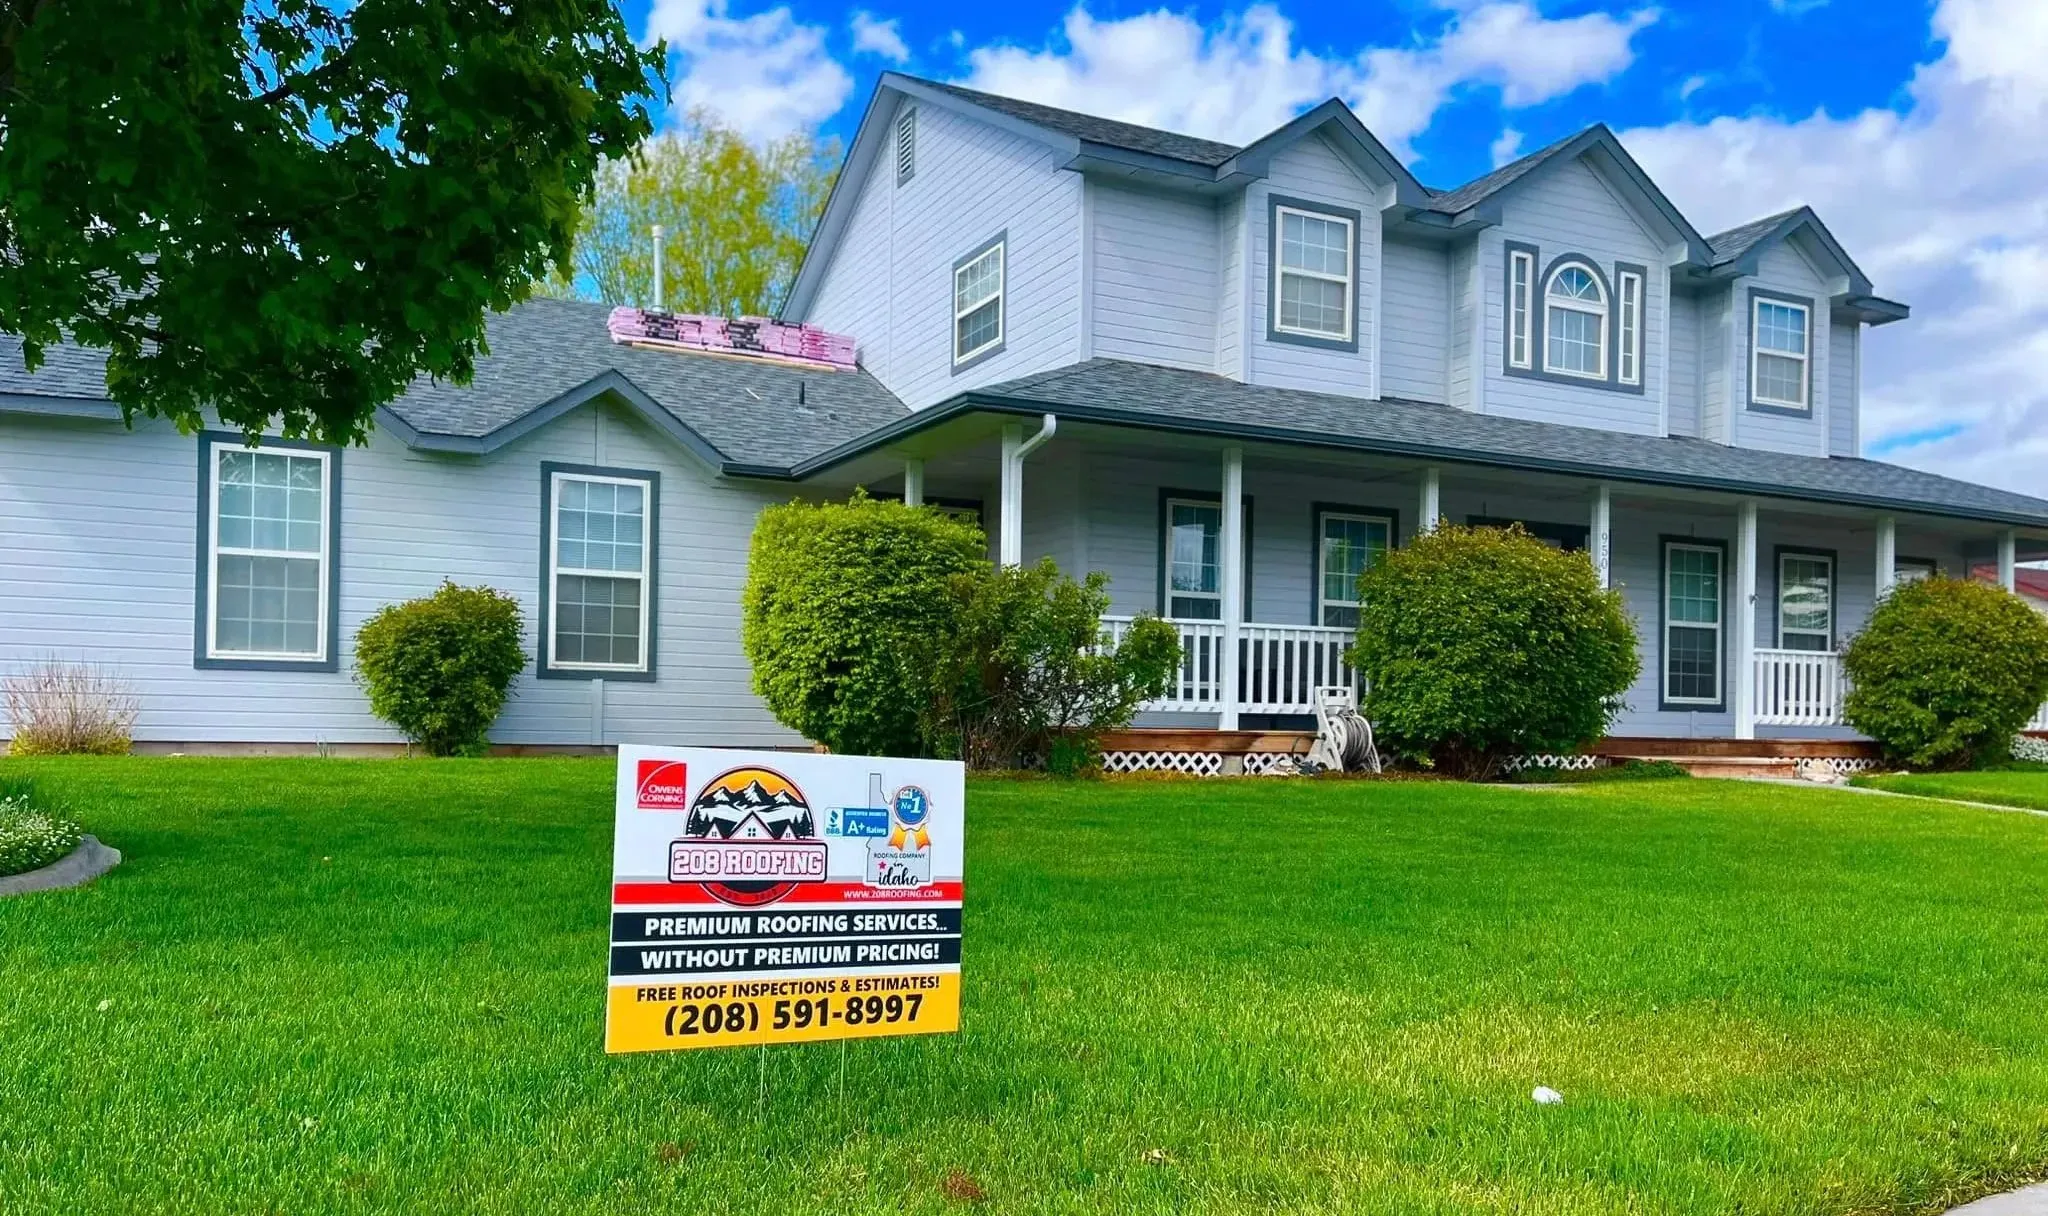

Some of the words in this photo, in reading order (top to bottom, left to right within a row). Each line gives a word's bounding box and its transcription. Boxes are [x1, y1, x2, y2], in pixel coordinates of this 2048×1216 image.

[640, 793, 683, 802] CORNING
[648, 784, 683, 794] OWENS
[847, 820, 865, 835] A+
[672, 849, 722, 876] 208
[724, 849, 824, 875] ROOFING
[843, 889, 943, 900] WWW.208ROOFING.COM
[645, 917, 752, 936] PREMIUM
[757, 915, 847, 934] ROOFING
[641, 948, 748, 970] WITHOUT
[754, 945, 851, 966] PREMIUM
[856, 943, 940, 963] PRICING!
[636, 987, 677, 1003] FREE
[682, 985, 728, 1001] ROOF
[732, 980, 836, 998] INSPECTIONS
[840, 979, 851, 993] &
[856, 976, 940, 992] ESTIMATES!
[664, 1001, 759, 1037] (208)
[773, 994, 923, 1030] 591-8997
